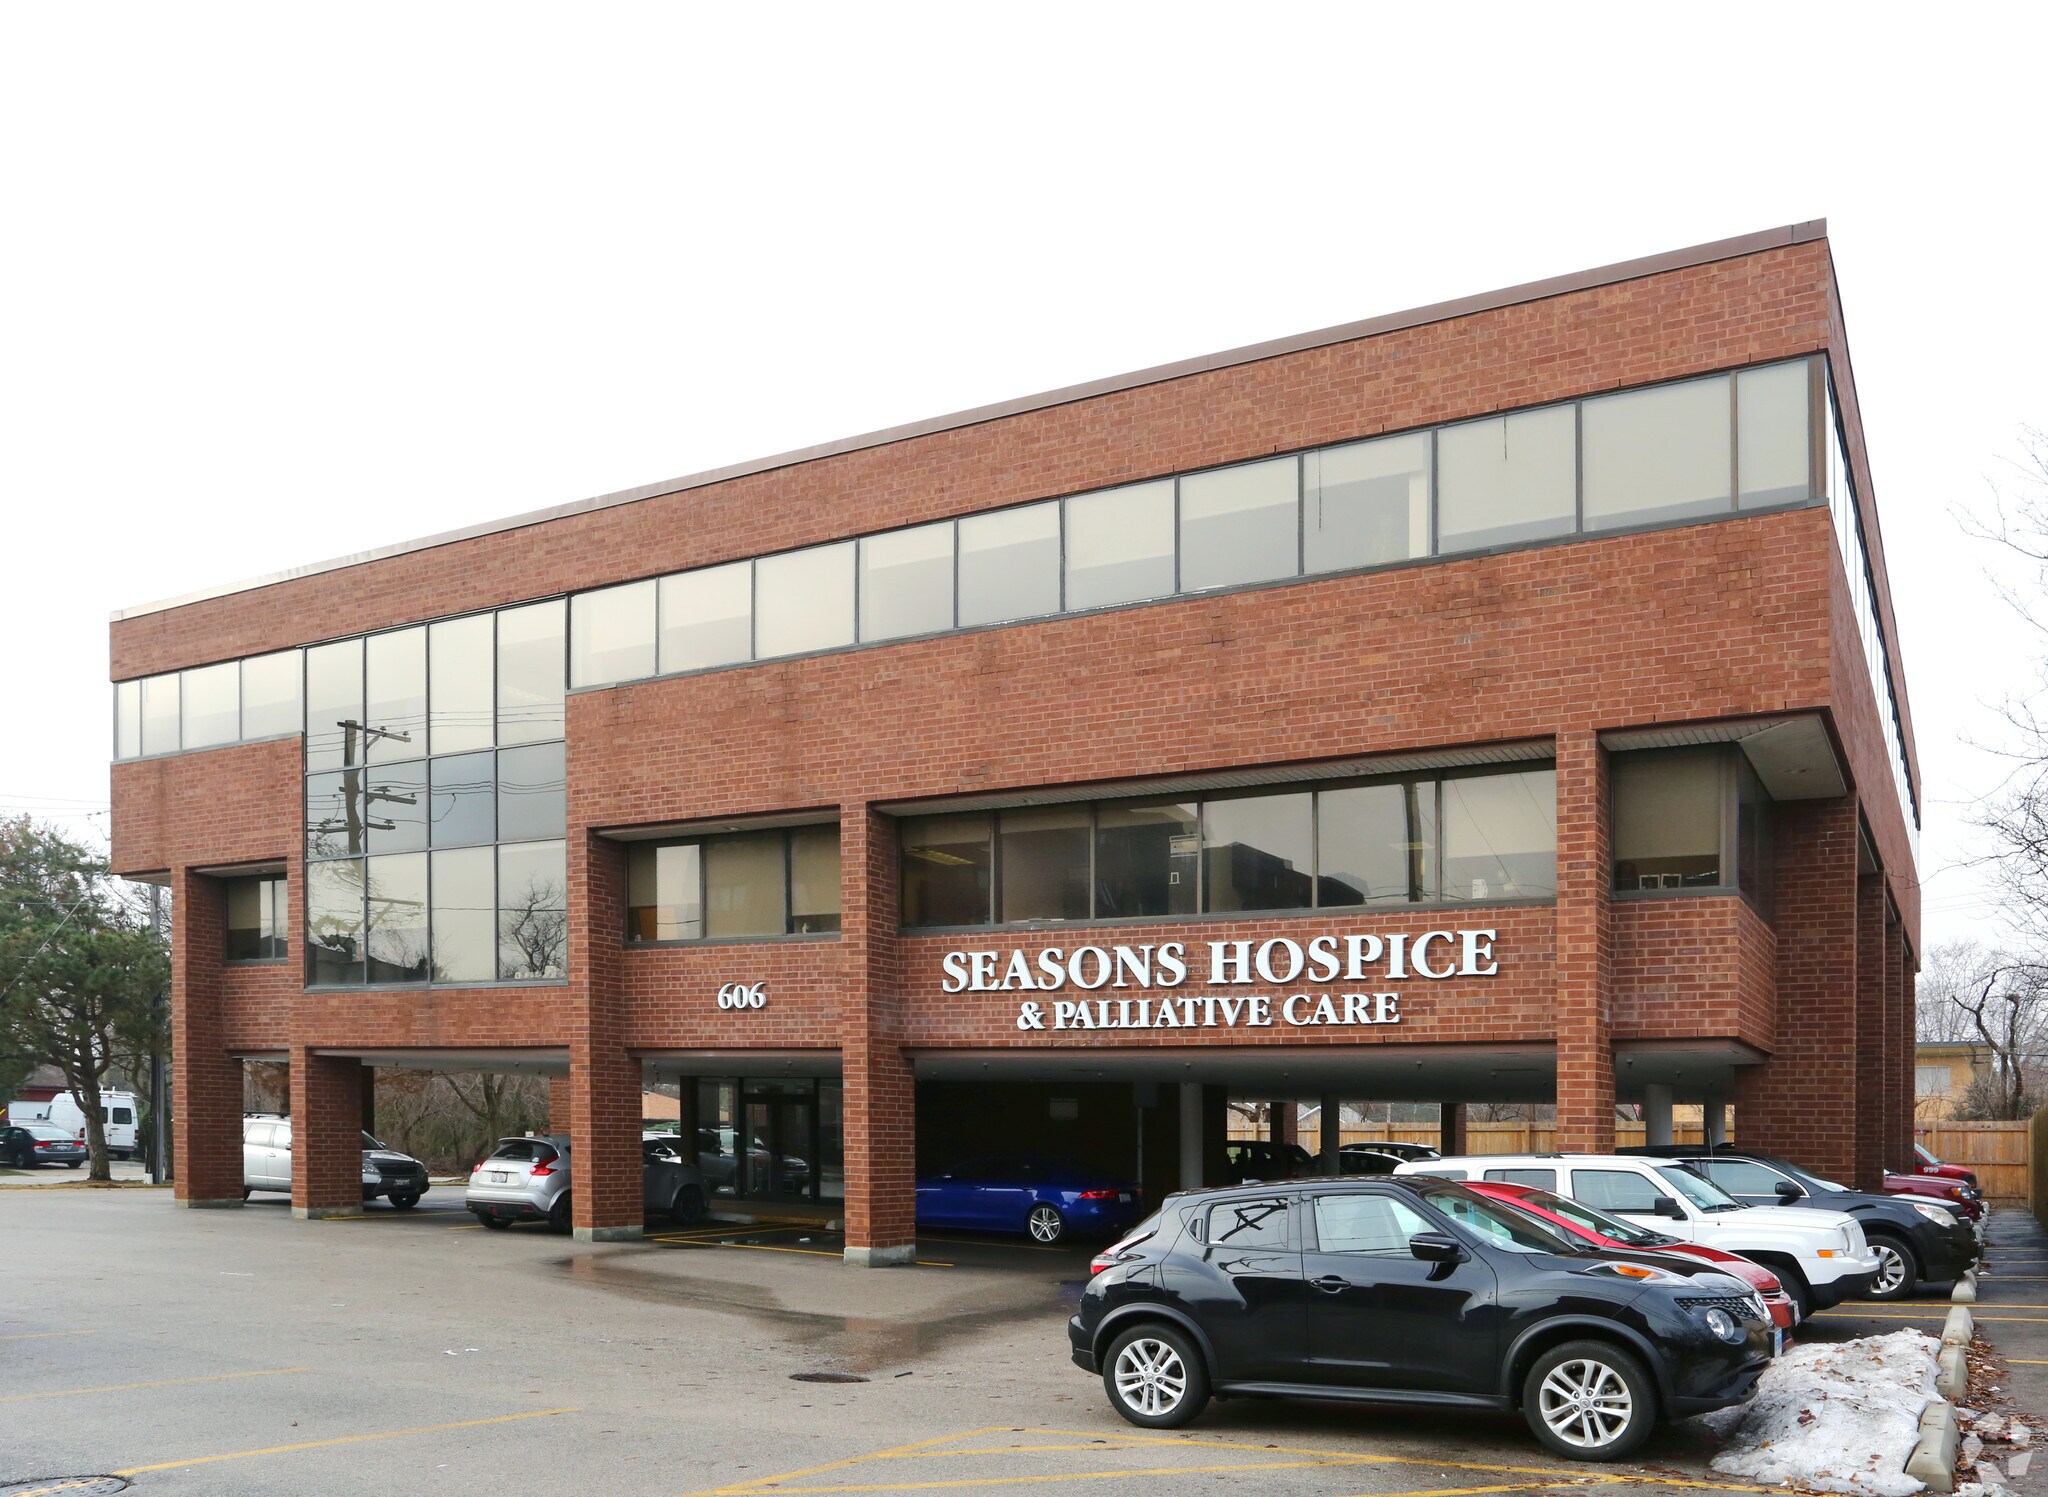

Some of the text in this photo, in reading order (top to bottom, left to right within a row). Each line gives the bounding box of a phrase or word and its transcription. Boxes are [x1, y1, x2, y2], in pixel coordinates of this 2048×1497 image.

[942, 929, 1499, 993] SEASONS HOSPICE
[718, 982, 767, 1010] 606
[1016, 992, 1401, 1031] & PALLIATIVE CARE
